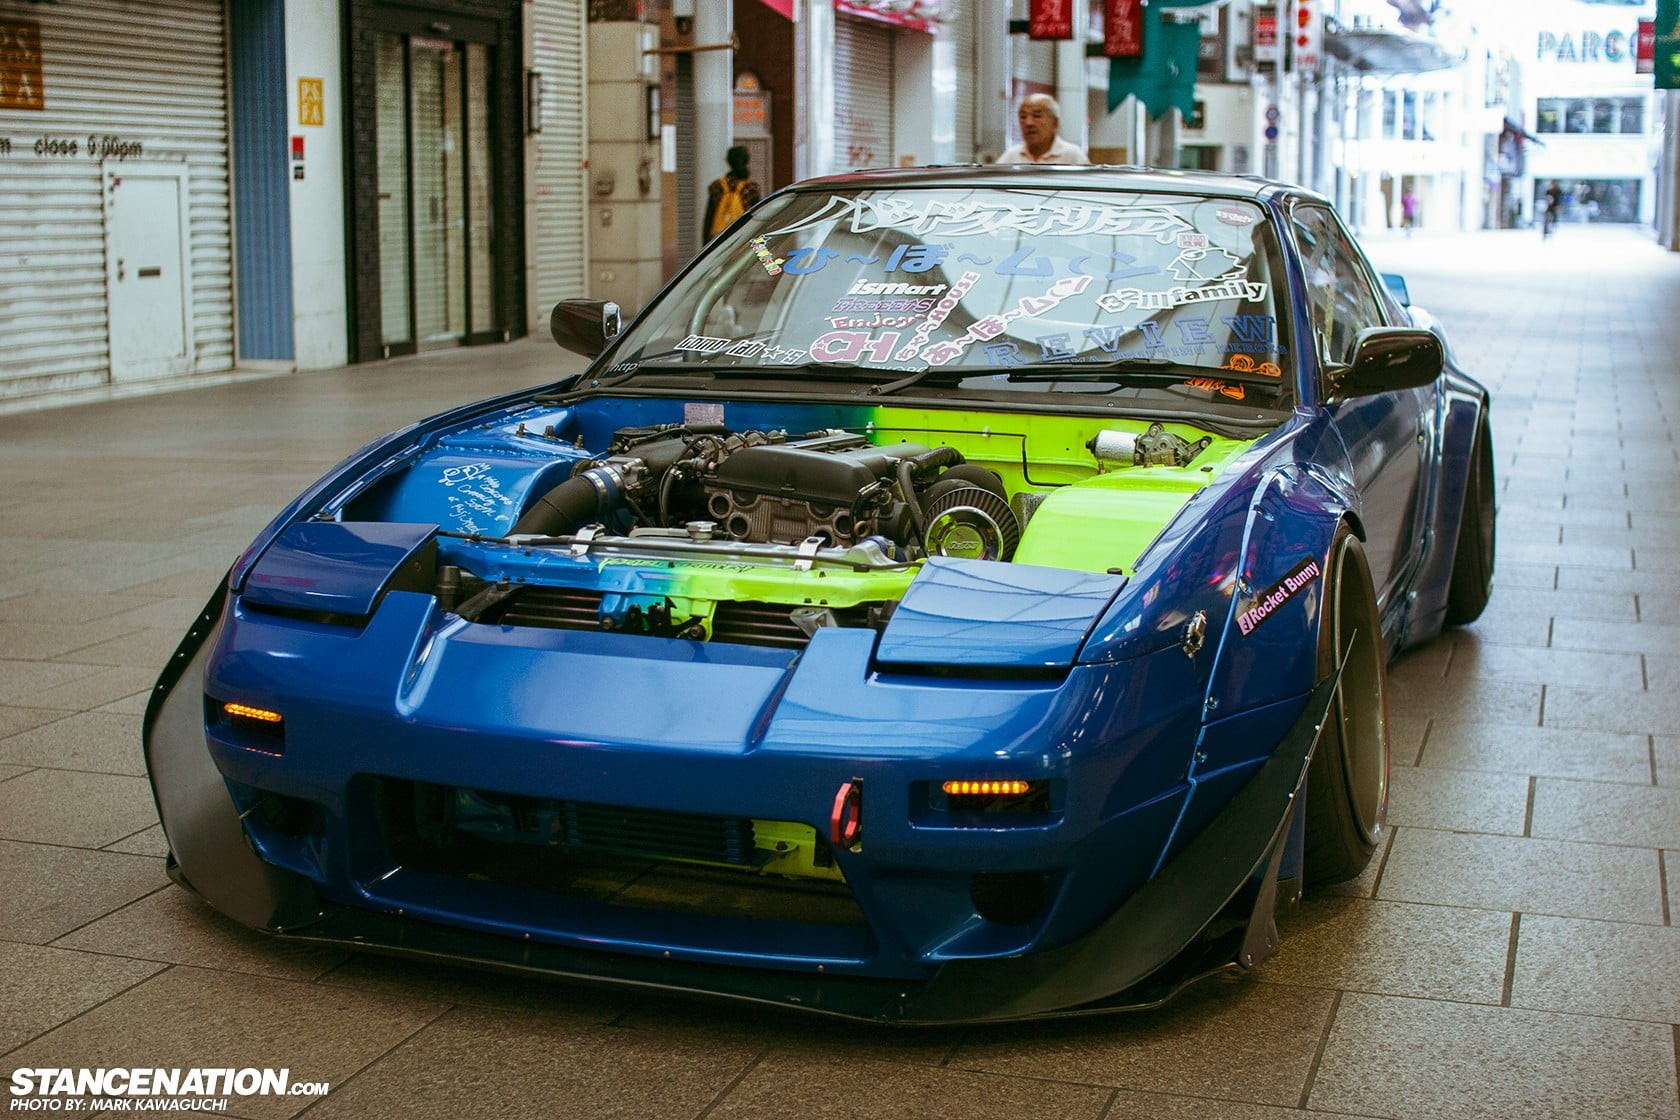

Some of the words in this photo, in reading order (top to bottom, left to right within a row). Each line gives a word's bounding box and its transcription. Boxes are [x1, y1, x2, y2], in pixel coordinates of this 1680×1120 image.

[34, 133, 78, 155] close
[848, 279, 947, 295] ismart
[983, 314, 1277, 381] REVIEW
[1249, 586, 1290, 623] Rocket
[1284, 561, 1320, 593] Bunny
